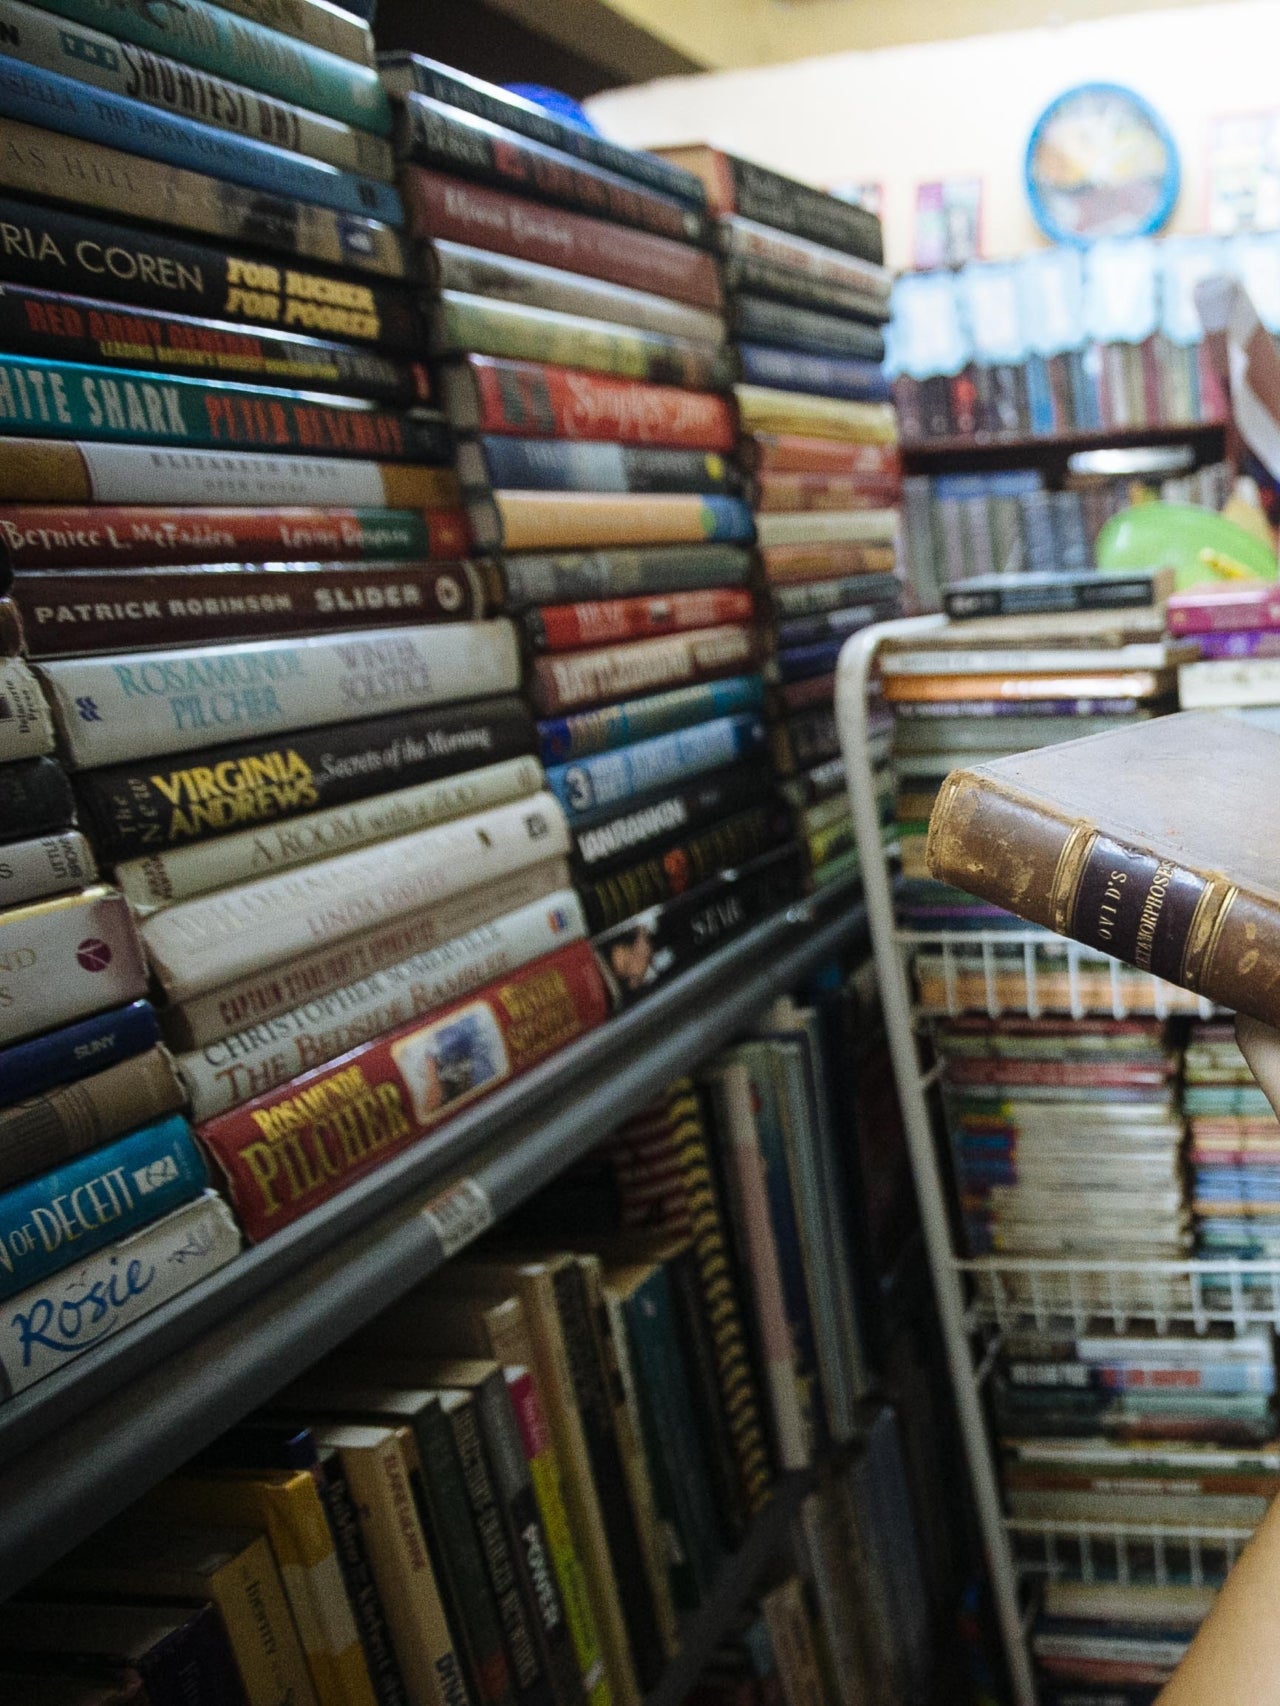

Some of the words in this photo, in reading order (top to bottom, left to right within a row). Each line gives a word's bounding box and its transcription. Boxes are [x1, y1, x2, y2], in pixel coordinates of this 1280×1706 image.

[0, 222, 67, 266] RIA
[76, 239, 204, 294] COREN
[24, 300, 84, 337] RED
[82, 376, 188, 437] SHARK
[5, 519, 101, 551] Bernice
[106, 519, 132, 551] L.
[34, 599, 162, 625] PATRICK
[169, 593, 294, 619] ROBINSON
[314, 583, 421, 614] SLIDER
[111, 646, 308, 699] ROSAMUNDE
[170, 685, 283, 735] PILCHER
[152, 749, 313, 806] VIRGINIA
[320, 748, 386, 782] Secrets
[384, 741, 403, 768] of
[399, 735, 426, 763] the
[425, 725, 493, 758] Morning
[169, 777, 319, 841] ANDREWS
[276, 812, 366, 858] ROOM
[1099, 870, 1128, 940] OVID'S
[1134, 860, 1178, 968] ETAMORPHOSES
[206, 969, 388, 1066] CHRISTOPHER
[213, 1047, 288, 1096] THE
[237, 1080, 412, 1217] PILCHER
[10, 1223, 38, 1257] OF
[33, 1165, 136, 1254] DECEIT
[11, 1256, 156, 1367] Rosie
